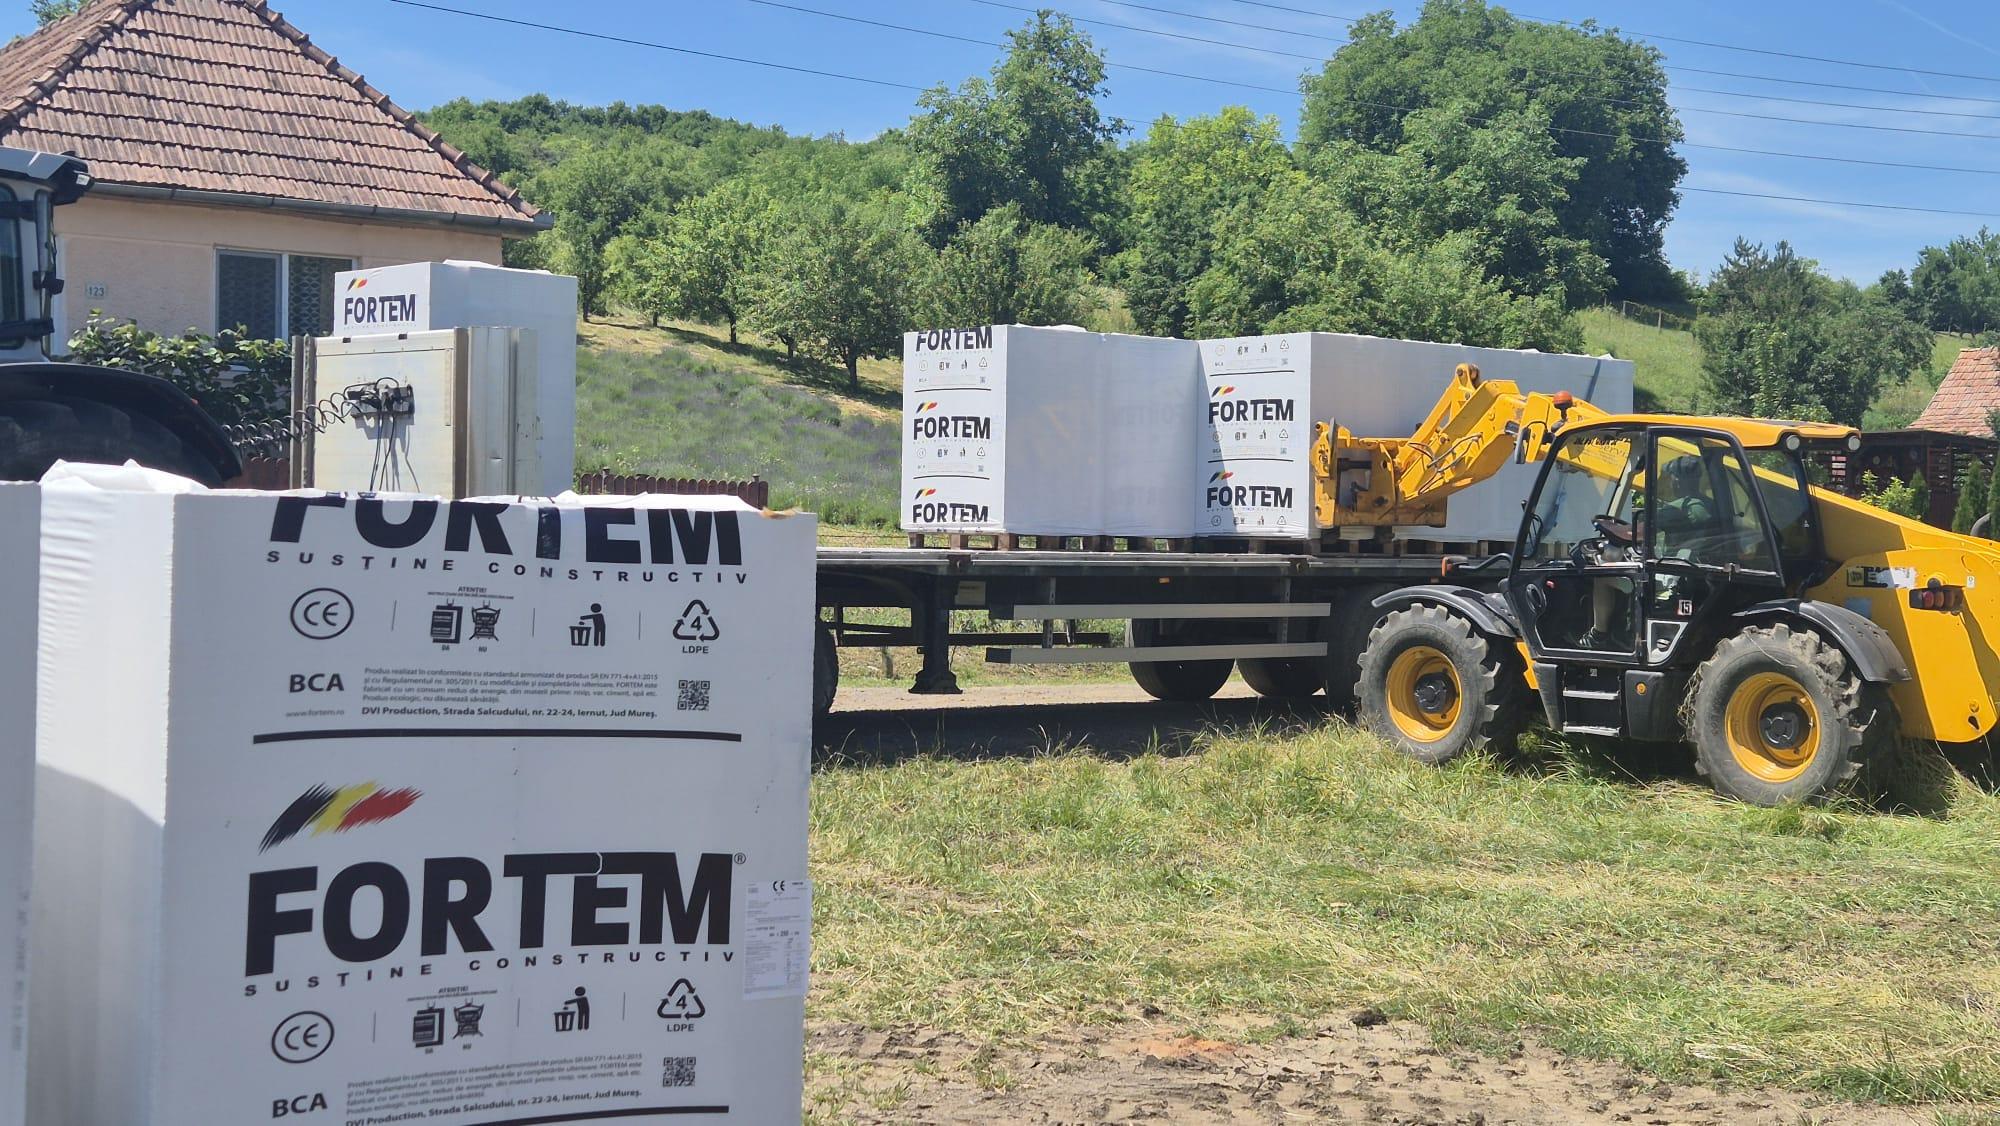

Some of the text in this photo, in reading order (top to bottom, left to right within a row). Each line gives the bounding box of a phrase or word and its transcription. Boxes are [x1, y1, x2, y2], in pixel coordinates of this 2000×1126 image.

[89, 286, 105, 297] 123
[344, 294, 416, 325] FORTEM
[915, 326, 993, 352] FORTEM
[1208, 398, 1294, 425] FORTEM
[913, 416, 991, 440] FORTEM
[1206, 485, 1293, 509] FORTEM
[912, 502, 989, 523] FORTEM
[488, 562, 747, 584] CONSTRUCTIV
[682, 645, 710, 654] LDPE
[289, 673, 345, 693] BCA
[362, 706, 380, 715] DVI
[382, 706, 440, 716] Production,
[443, 707, 475, 716] Strada
[477, 707, 530, 717] Salcudului,
[546, 708, 576, 718] 22-24,
[578, 708, 608, 718] Iernut,
[610, 709, 626, 718] Jud
[469, 951, 734, 971] CONSTRUCTIV
[666, 1023, 695, 1032] LDPE
[272, 1092, 328, 1119] BCA
[367, 1110, 426, 1124] Production,
[428, 1106, 462, 1117] Strada
[594, 1090, 611, 1099] Jud
